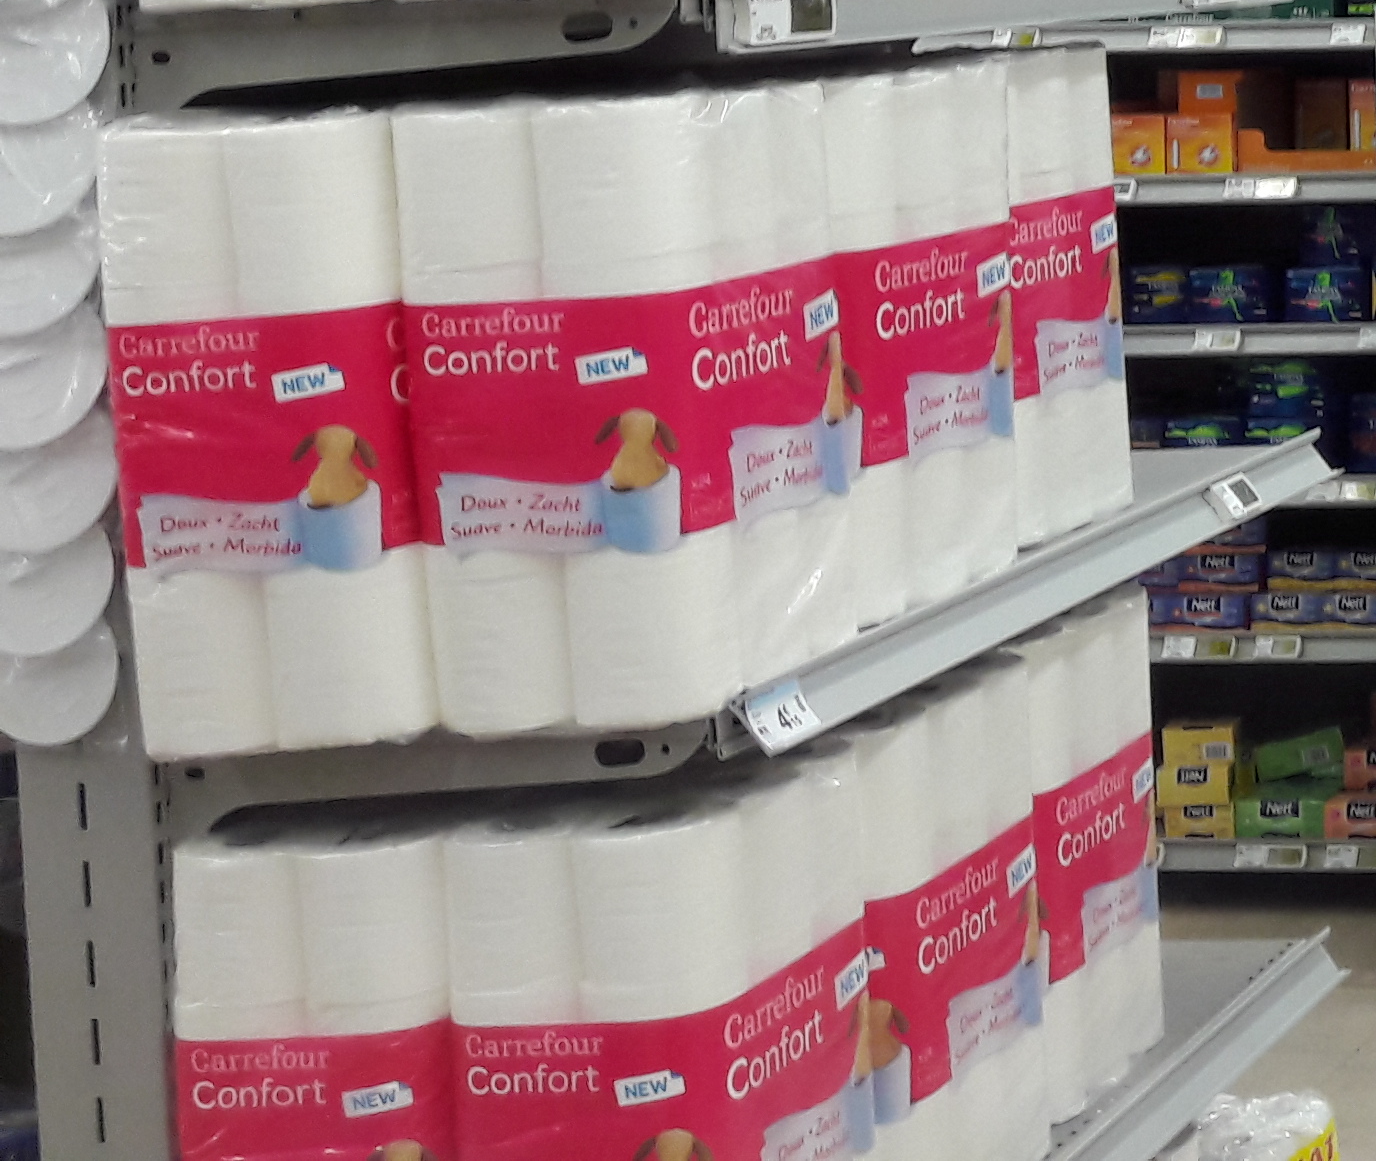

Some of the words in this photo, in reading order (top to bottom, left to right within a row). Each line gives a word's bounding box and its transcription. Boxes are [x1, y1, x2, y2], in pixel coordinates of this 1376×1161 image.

[1093, 222, 1115, 247] NEW
[874, 246, 969, 293] Carrefour
[982, 261, 1006, 289] NEW
[1010, 243, 1083, 289] Confort
[421, 307, 564, 339] Carrefour
[688, 285, 794, 338] Carrefour
[809, 297, 834, 330] NEW
[876, 287, 965, 341] Confort
[118, 326, 260, 360] Carrefour
[423, 341, 559, 378] Confort
[691, 328, 792, 391] Confort
[121, 360, 257, 399] Confort
[585, 354, 630, 377] NEW
[280, 372, 326, 396] NEW
[461, 494, 506, 513] Doux
[529, 493, 581, 514] Zacht
[159, 515, 208, 534] Doux
[227, 513, 281, 534] Zacht
[450, 520, 501, 540] Suave
[1055, 767, 1127, 827] Carrefour
[1057, 802, 1126, 867] Confort
[1011, 854, 1033, 884] NEW
[915, 856, 1000, 930] Carrefour
[917, 896, 998, 975] Confort
[840, 959, 866, 999] NEW
[723, 964, 825, 1050] Carrefour
[190, 1043, 330, 1075] Carrefour
[465, 1034, 603, 1060] Carrefour
[725, 1008, 824, 1101] Confort
[192, 1076, 327, 1110] Confort
[467, 1063, 600, 1096] Confort
[624, 1077, 669, 1102] NEW
[351, 1087, 397, 1112] NEW
